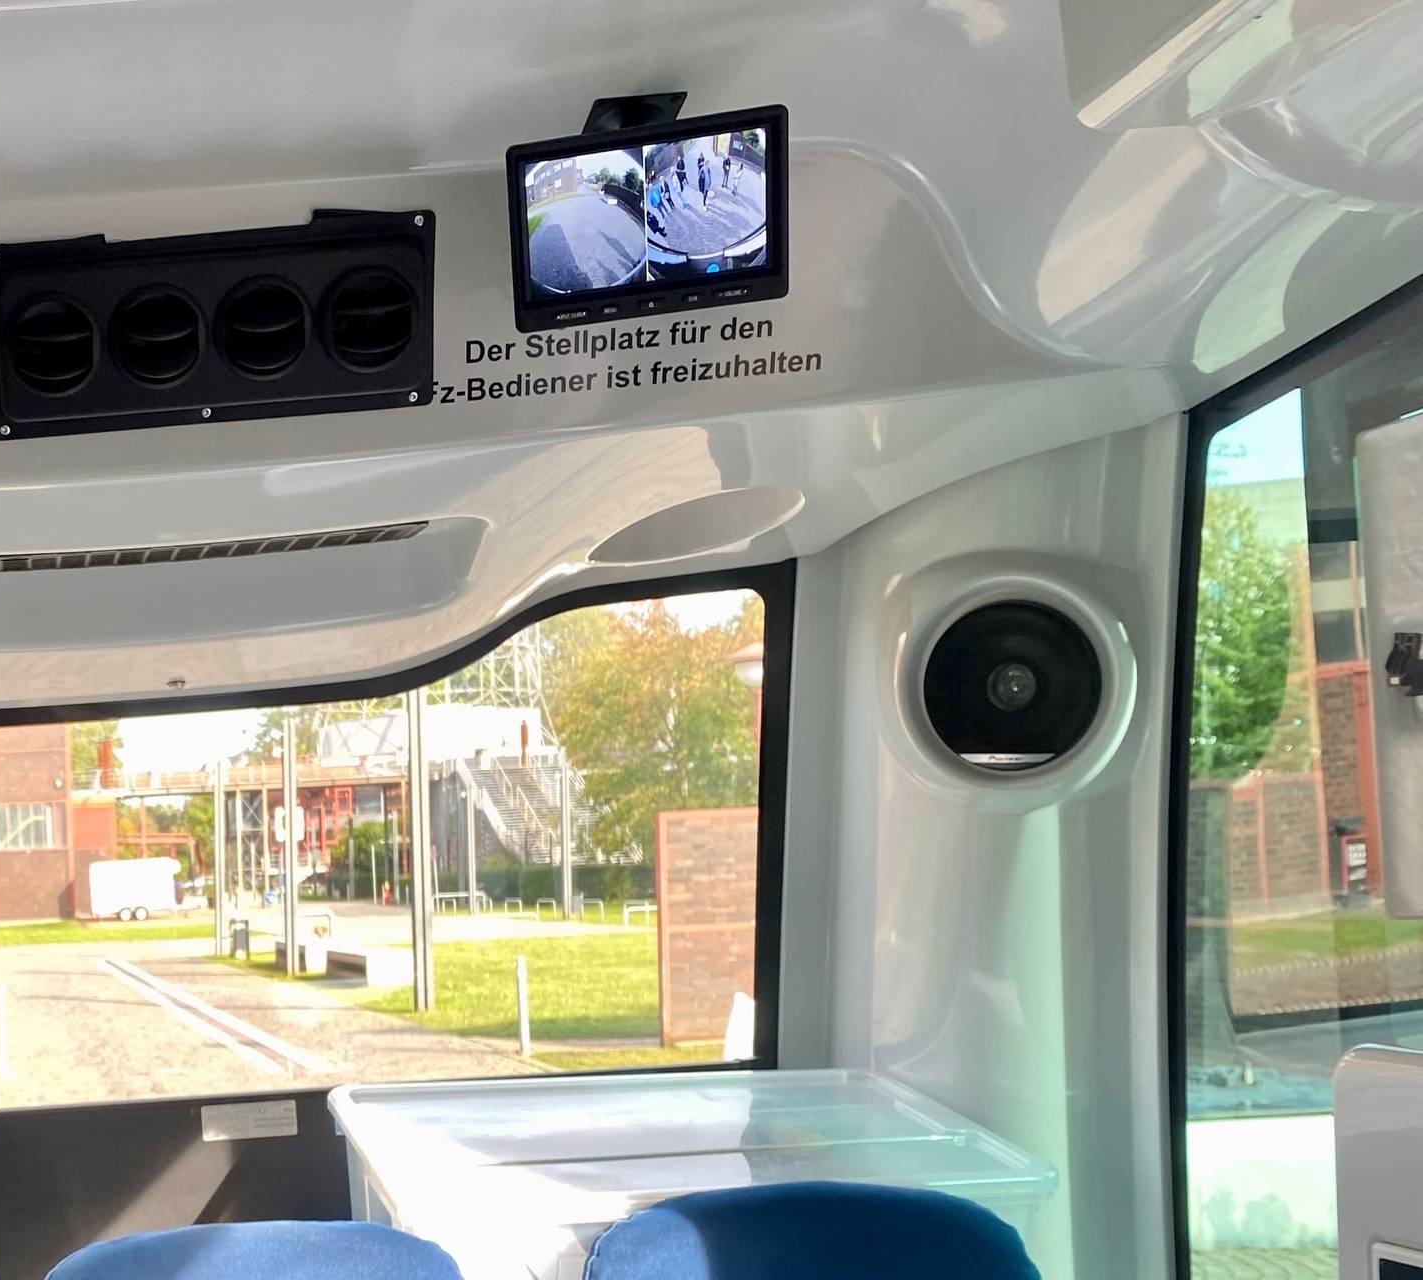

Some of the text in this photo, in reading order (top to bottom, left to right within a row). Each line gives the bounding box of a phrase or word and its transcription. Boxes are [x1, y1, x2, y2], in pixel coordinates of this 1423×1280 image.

[465, 316, 773, 364] Der Stellplatz für den
[606, 364, 642, 390] ist
[650, 351, 822, 386] freizuhalten
